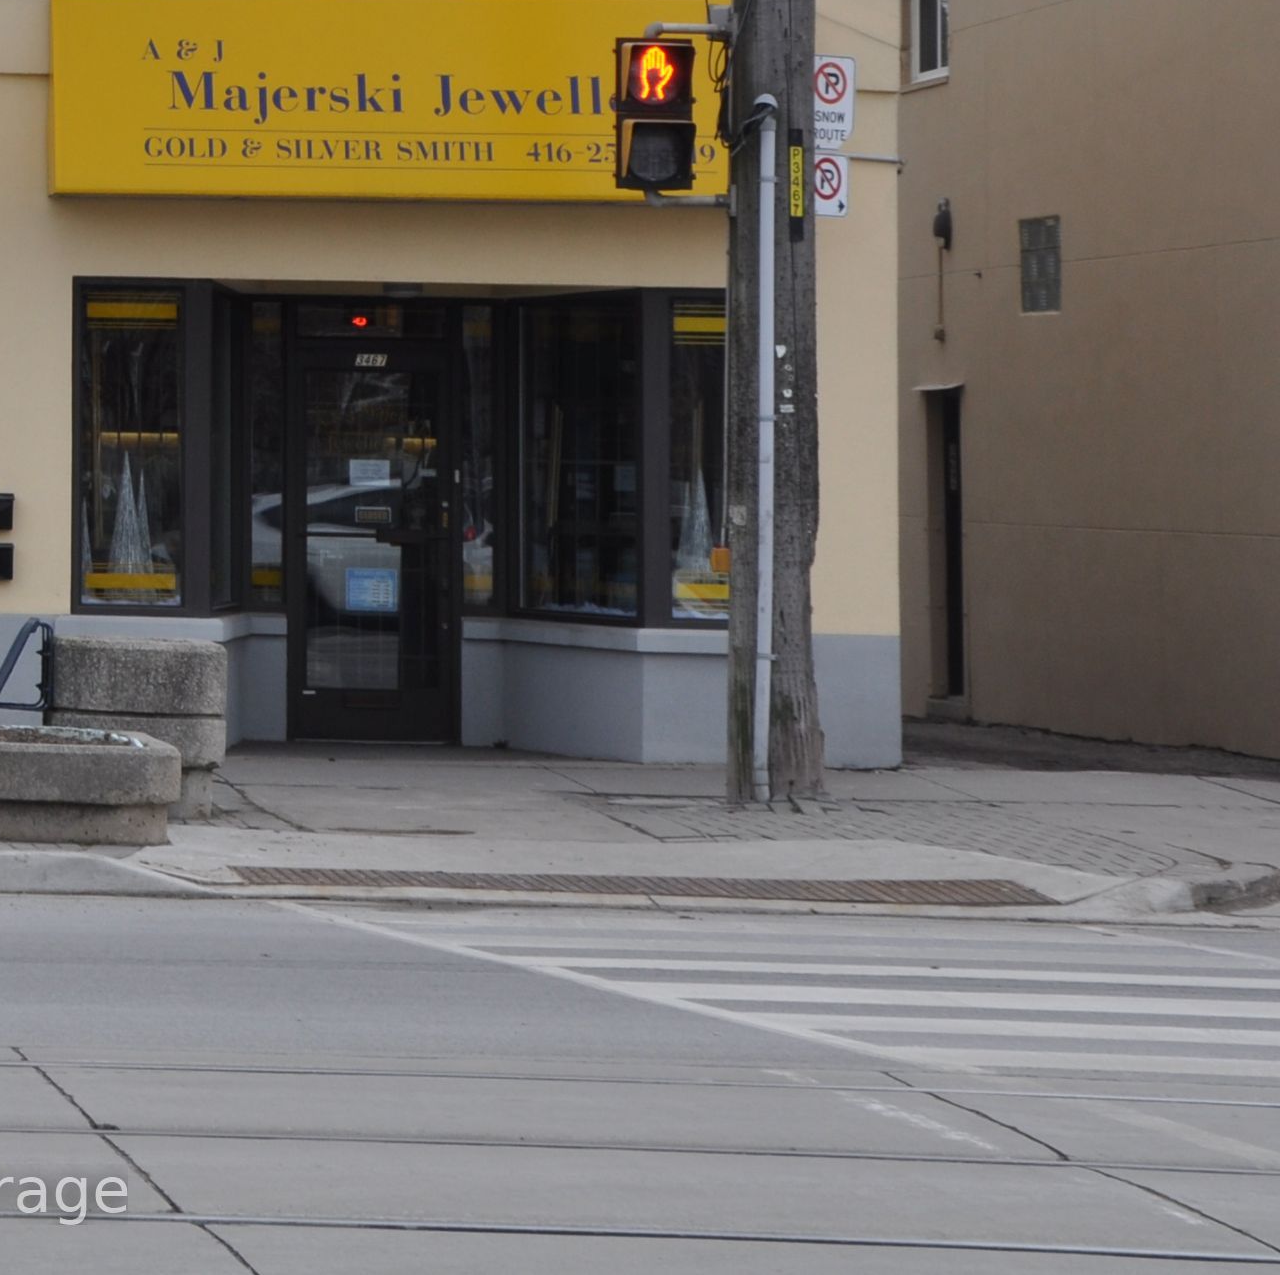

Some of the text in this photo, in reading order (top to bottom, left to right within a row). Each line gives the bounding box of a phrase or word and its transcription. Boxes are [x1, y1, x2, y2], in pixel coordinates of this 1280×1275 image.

[141, 38, 225, 63] A & J
[167, 71, 617, 124] Majerski Jewell
[815, 110, 846, 124] SNOW
[144, 136, 228, 159] GOLD
[241, 138, 263, 159] &
[276, 138, 384, 161] SILVER
[396, 140, 495, 162] SMITH
[791, 148, 802, 216] P3467
[356, 354, 386, 366] 3467
